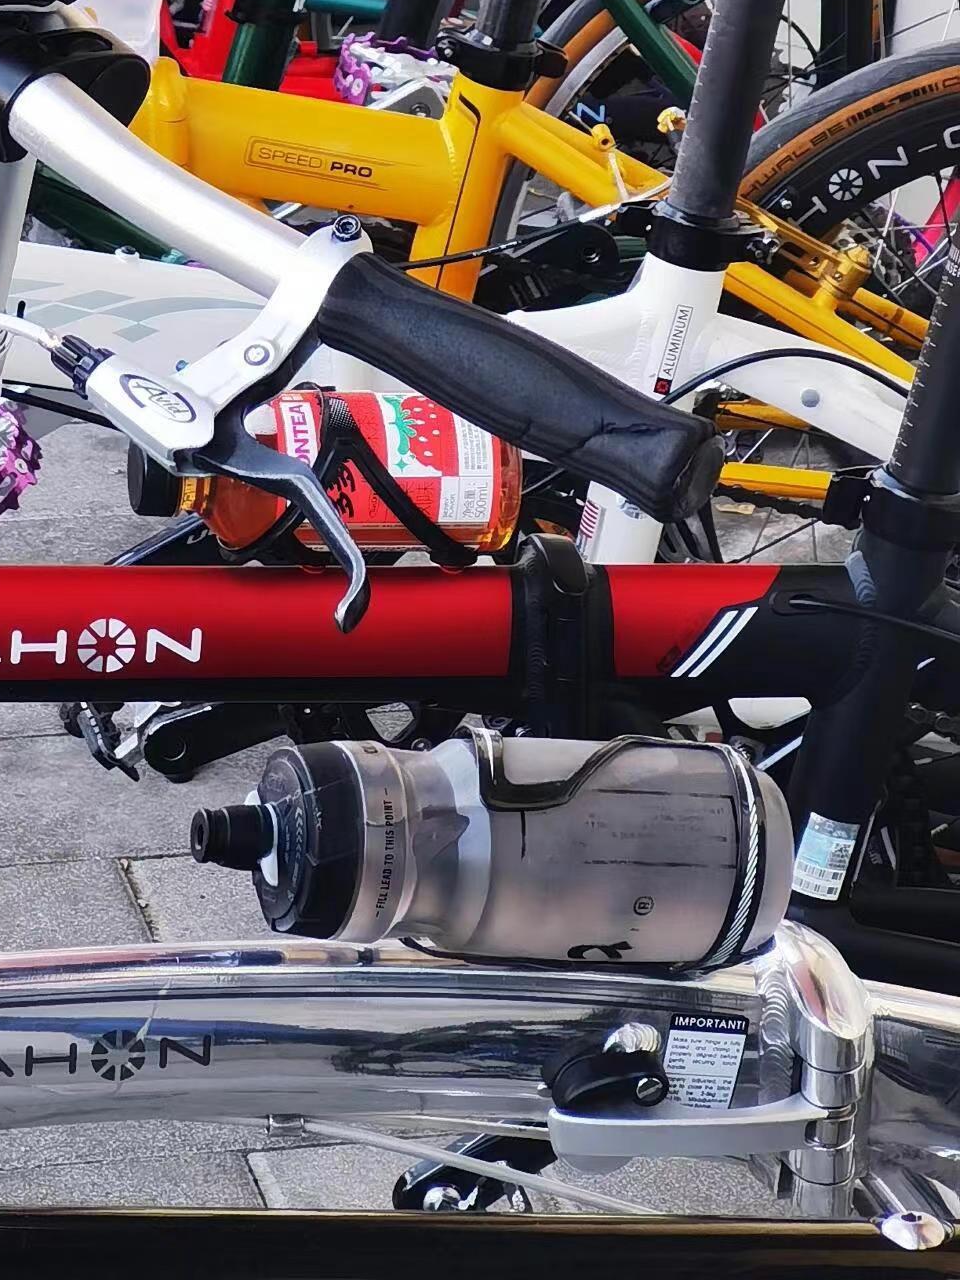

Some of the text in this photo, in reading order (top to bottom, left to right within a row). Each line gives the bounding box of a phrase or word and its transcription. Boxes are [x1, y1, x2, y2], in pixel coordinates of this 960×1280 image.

[258, 147, 373, 178] SPEED PRO
[663, 308, 690, 377] ALUMINUM
[383, 800, 394, 827] POINT
[385, 830, 394, 851] THIS
[384, 853, 394, 865] TO
[376, 891, 388, 909] FILL
[674, 1016, 746, 1030] IMPORTANT!
